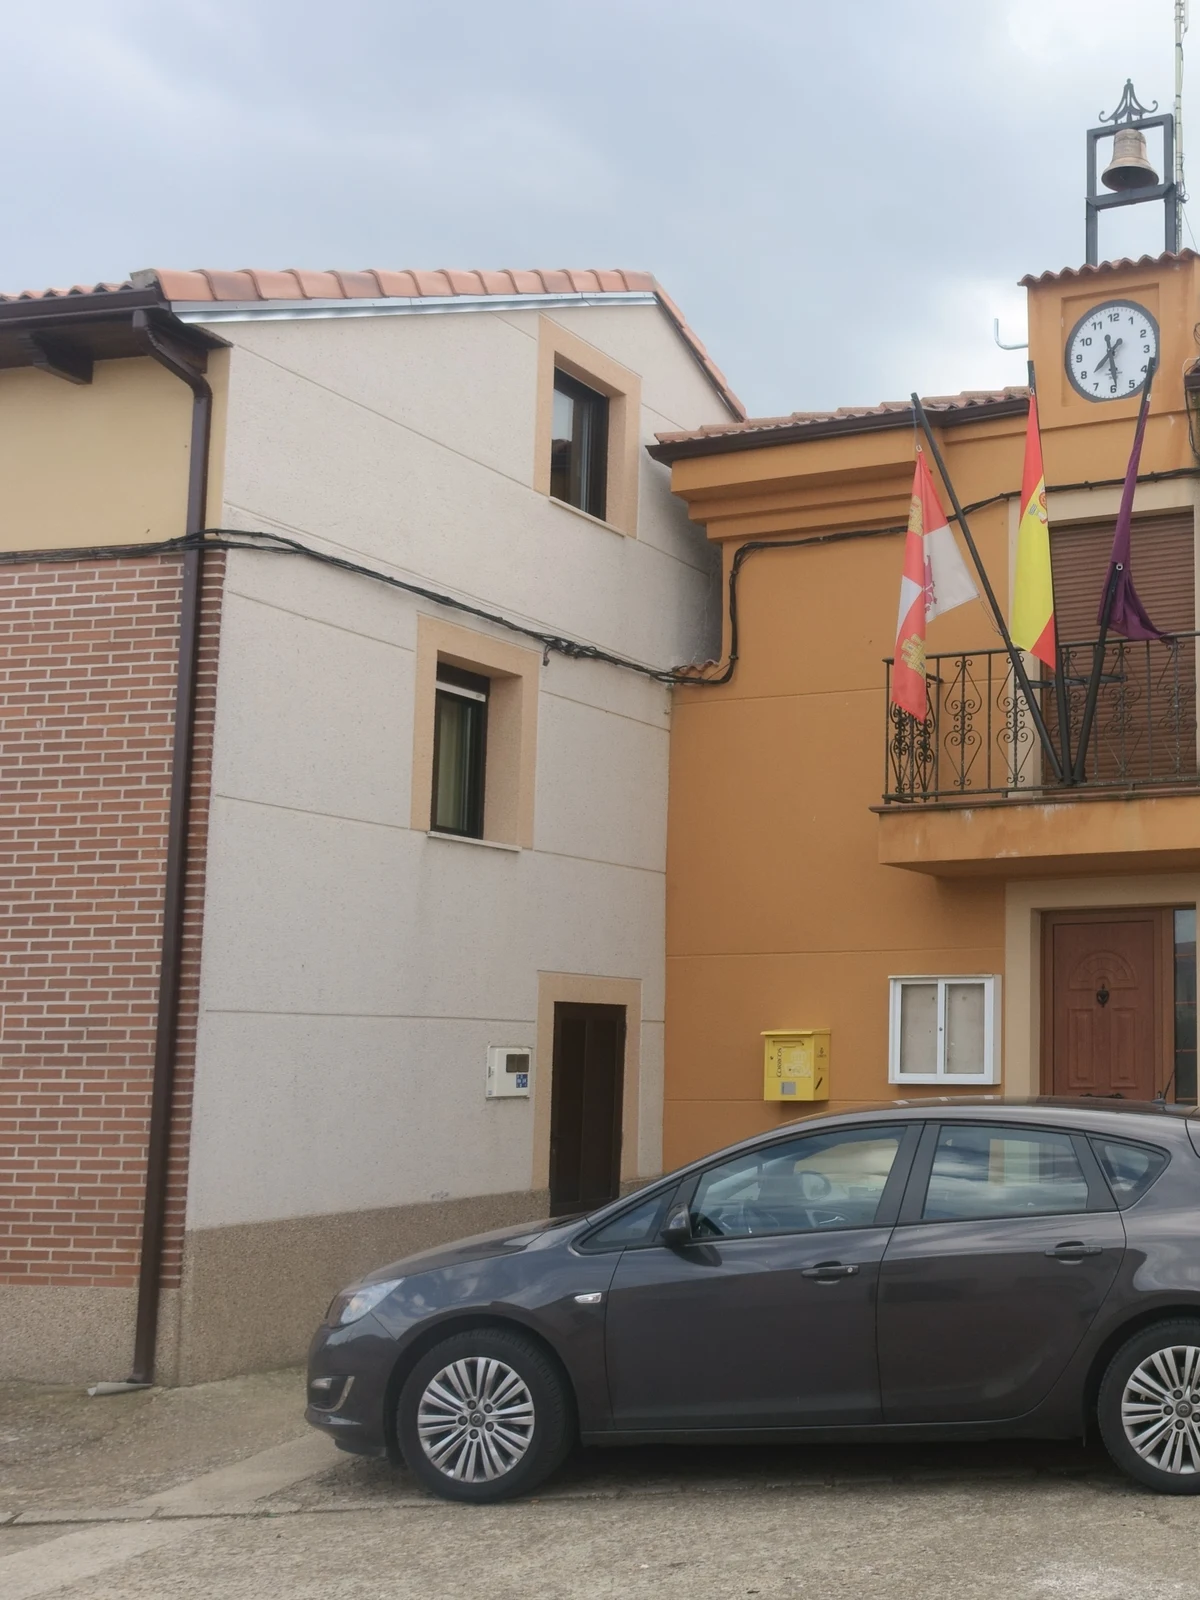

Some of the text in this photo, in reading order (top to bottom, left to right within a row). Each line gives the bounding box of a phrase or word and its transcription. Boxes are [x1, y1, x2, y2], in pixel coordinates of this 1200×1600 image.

[1107, 313, 1120, 322] 12
[1128, 316, 1134, 325] 1
[1091, 321, 1103, 331] 11
[1139, 329, 1147, 338] 2
[1079, 337, 1092, 347] 10
[1143, 344, 1150, 353] 3
[1075, 354, 1083, 363] 9
[1140, 365, 1148, 374] 4
[1080, 371, 1087, 380] 8
[1093, 382, 1099, 391] 7
[1128, 379, 1136, 388] 5
[1110, 384, 1117, 393] 6
